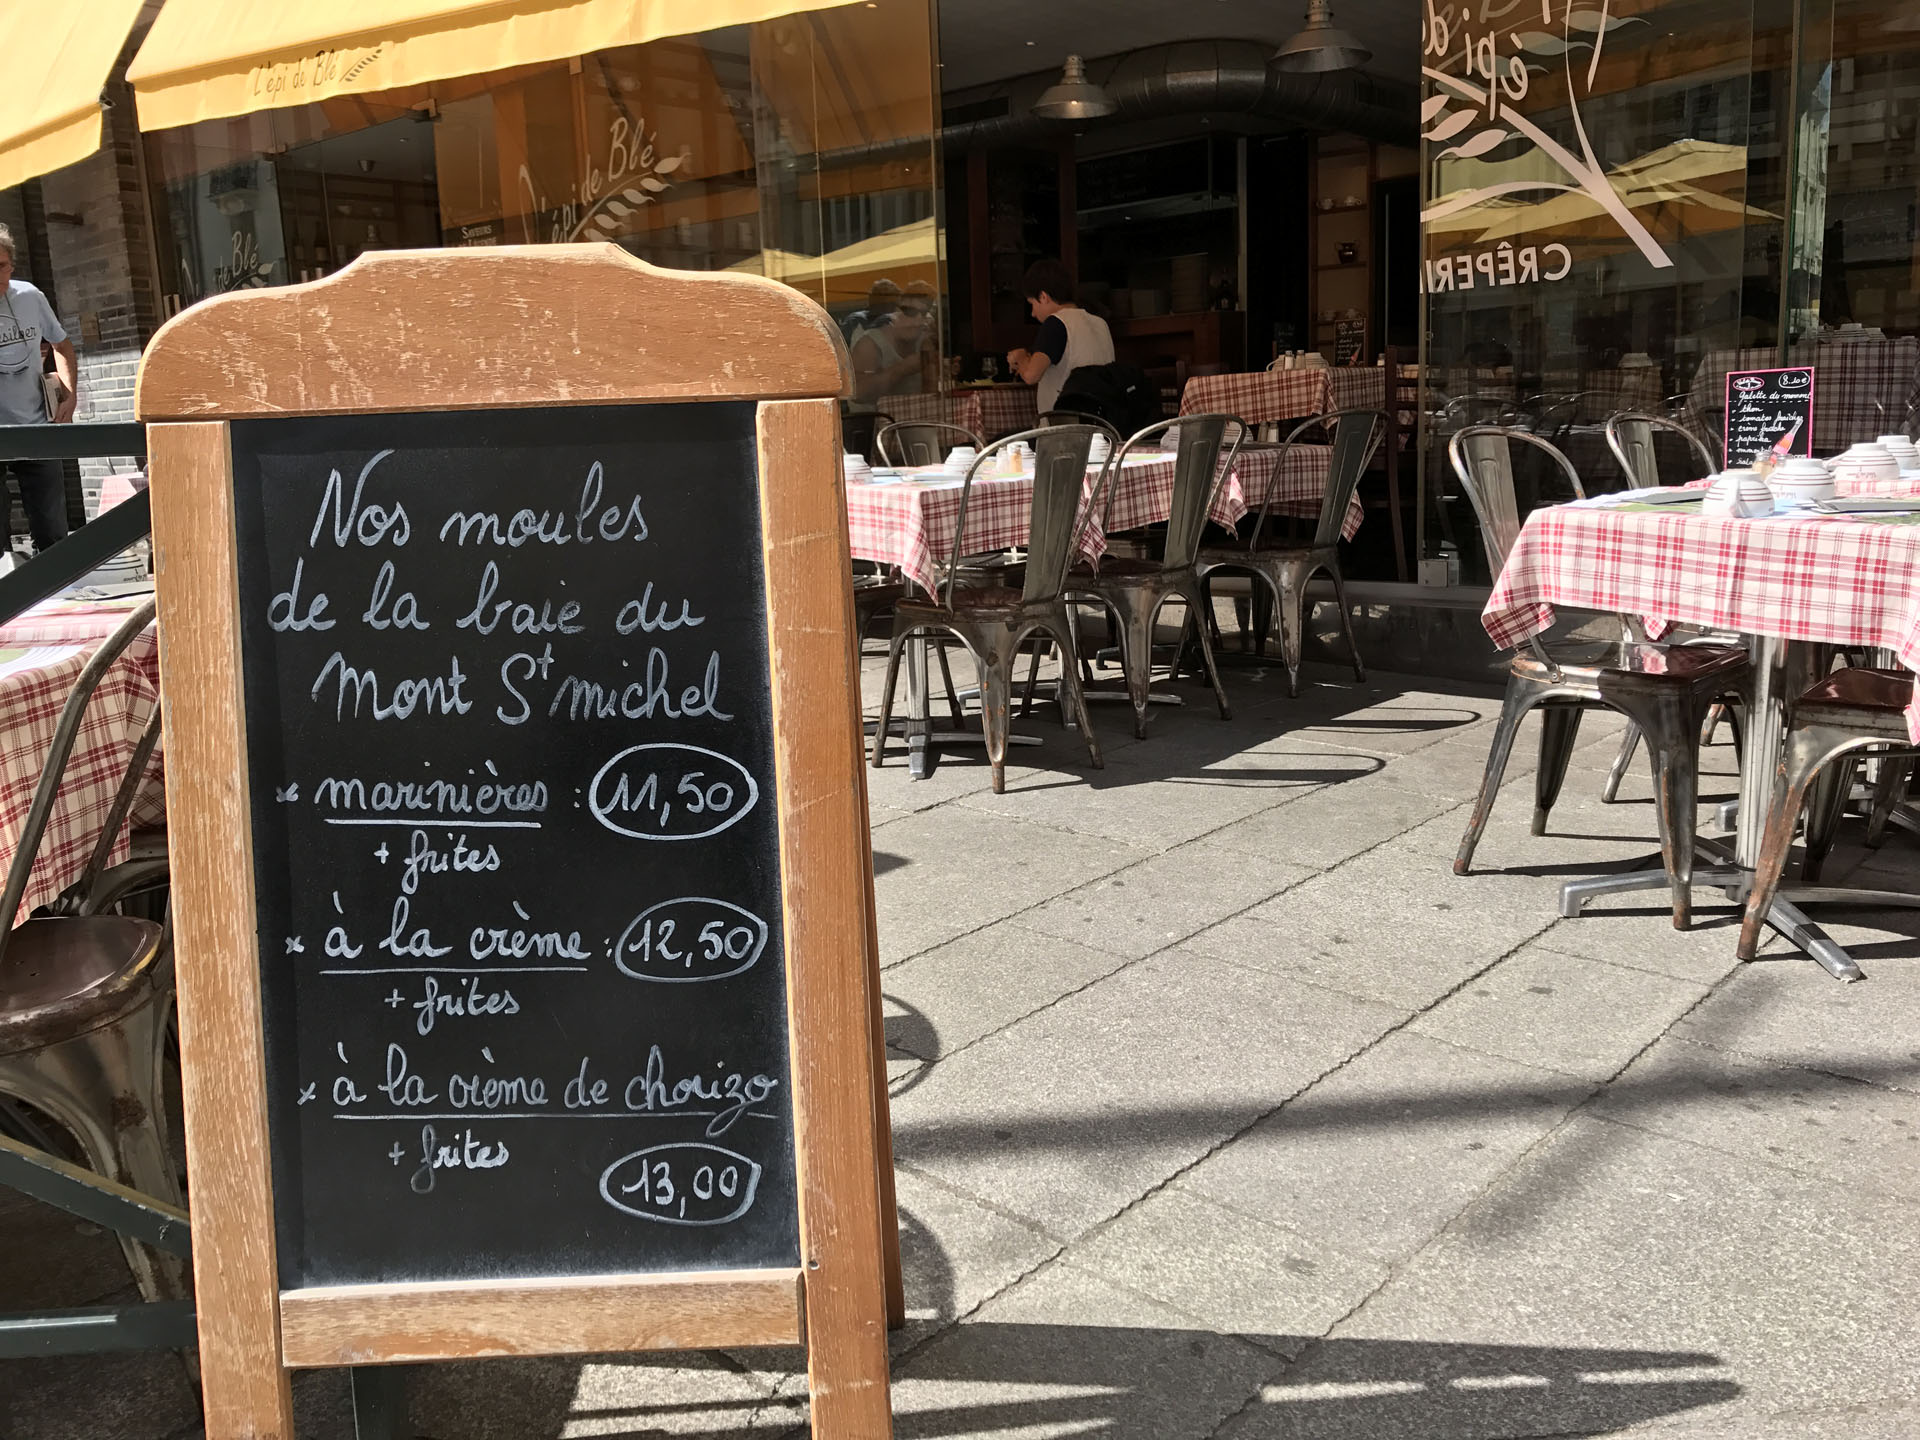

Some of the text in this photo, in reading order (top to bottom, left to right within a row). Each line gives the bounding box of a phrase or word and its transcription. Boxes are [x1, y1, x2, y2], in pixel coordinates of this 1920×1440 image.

[293, 58, 305, 88] de
[313, 49, 341, 88] Blé
[581, 154, 603, 206] de
[608, 116, 657, 182] Blé
[231, 231, 260, 279] Blé
[1739, 402, 1764, 413] thon
[1739, 413, 1772, 422] tomates
[1769, 391, 1780, 399] du
[1735, 431, 1772, 447] paprika
[310, 449, 648, 548] Nos moules
[268, 557, 705, 635] de la baie du
[312, 652, 472, 721] Mont
[314, 760, 548, 814] marinières
[600, 771, 735, 827] 11,50
[402, 829, 501, 894] frites
[325, 891, 363, 958] à
[379, 896, 453, 957] la
[470, 901, 591, 960] crème
[628, 919, 753, 968] 12,50
[413, 976, 520, 1036] frites
[333, 1042, 779, 1138] à la crème de chorizo
[411, 1124, 510, 1194] frites
[621, 1158, 739, 1219] 13,00
